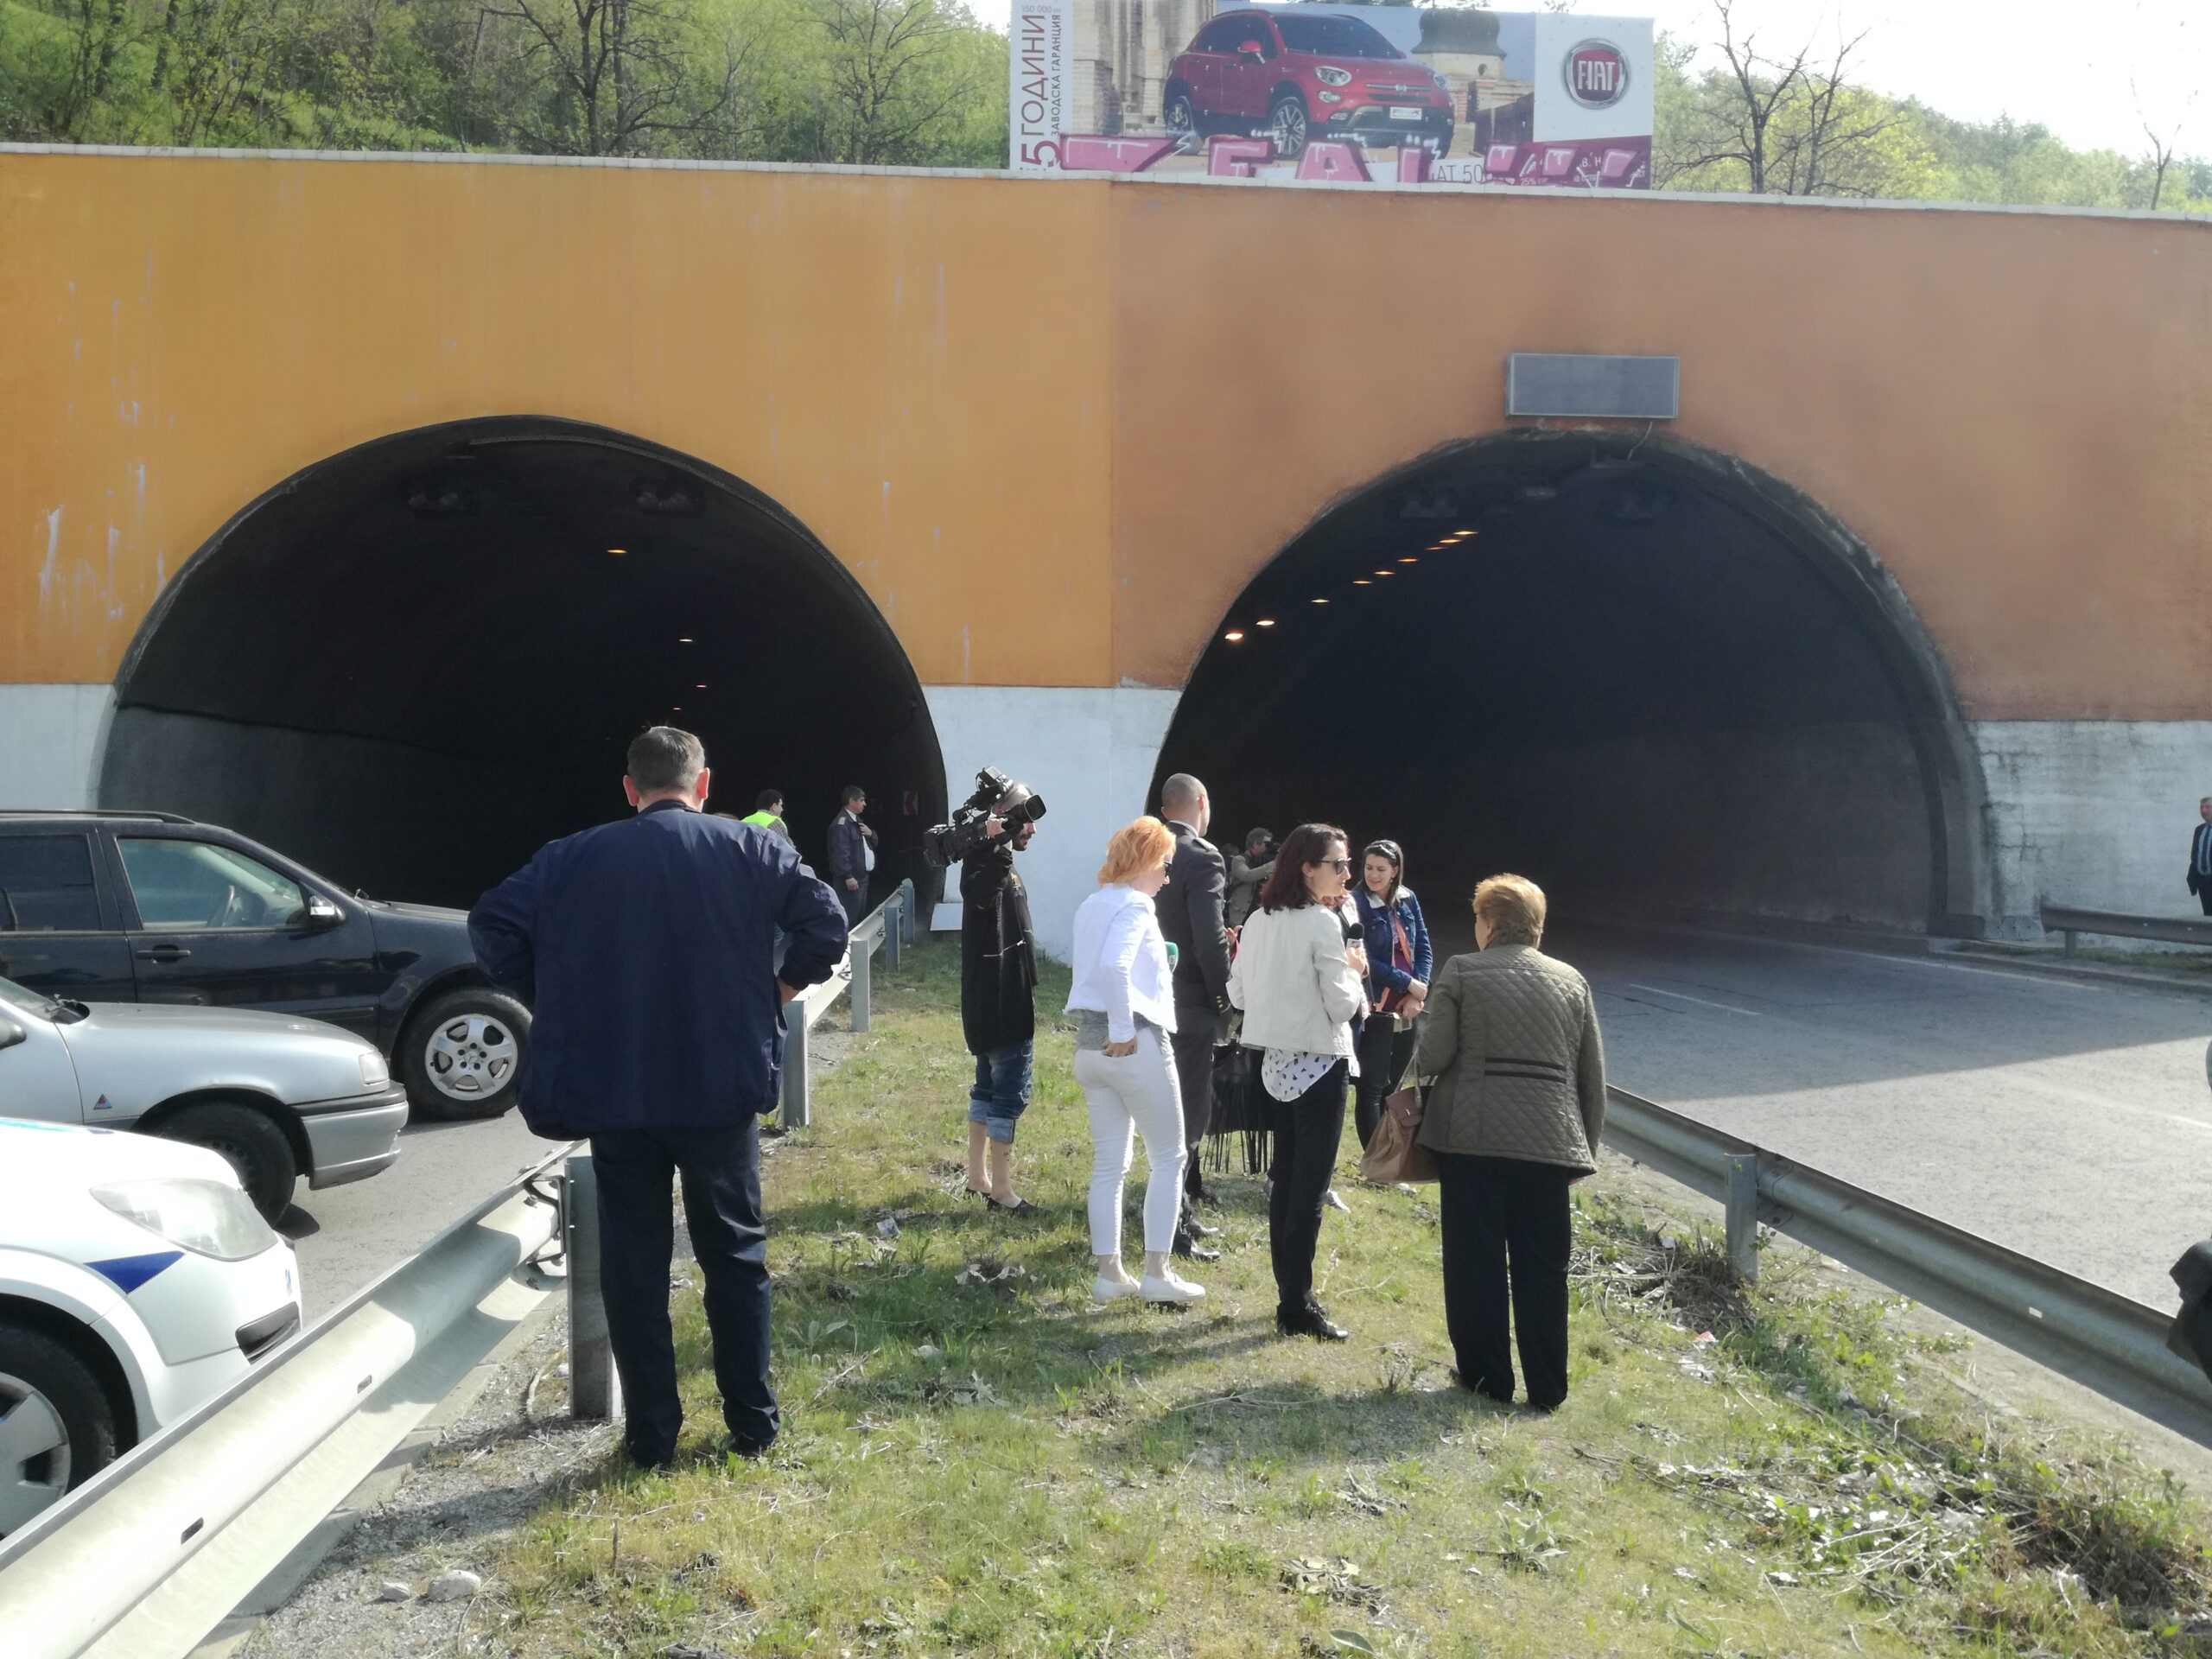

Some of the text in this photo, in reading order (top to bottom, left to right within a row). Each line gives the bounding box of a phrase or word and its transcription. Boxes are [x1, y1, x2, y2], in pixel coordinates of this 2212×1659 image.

[1037, 5, 1052, 14] 000
[1051, 15, 1062, 137] ЗАВОДСКА ГАРАНЦИЯ
[1578, 60, 1616, 91] FIAT
[1021, 15, 1062, 168] 5 ГОДИНИ
[1431, 164, 1457, 183] AT
[1463, 163, 1484, 185] 50
